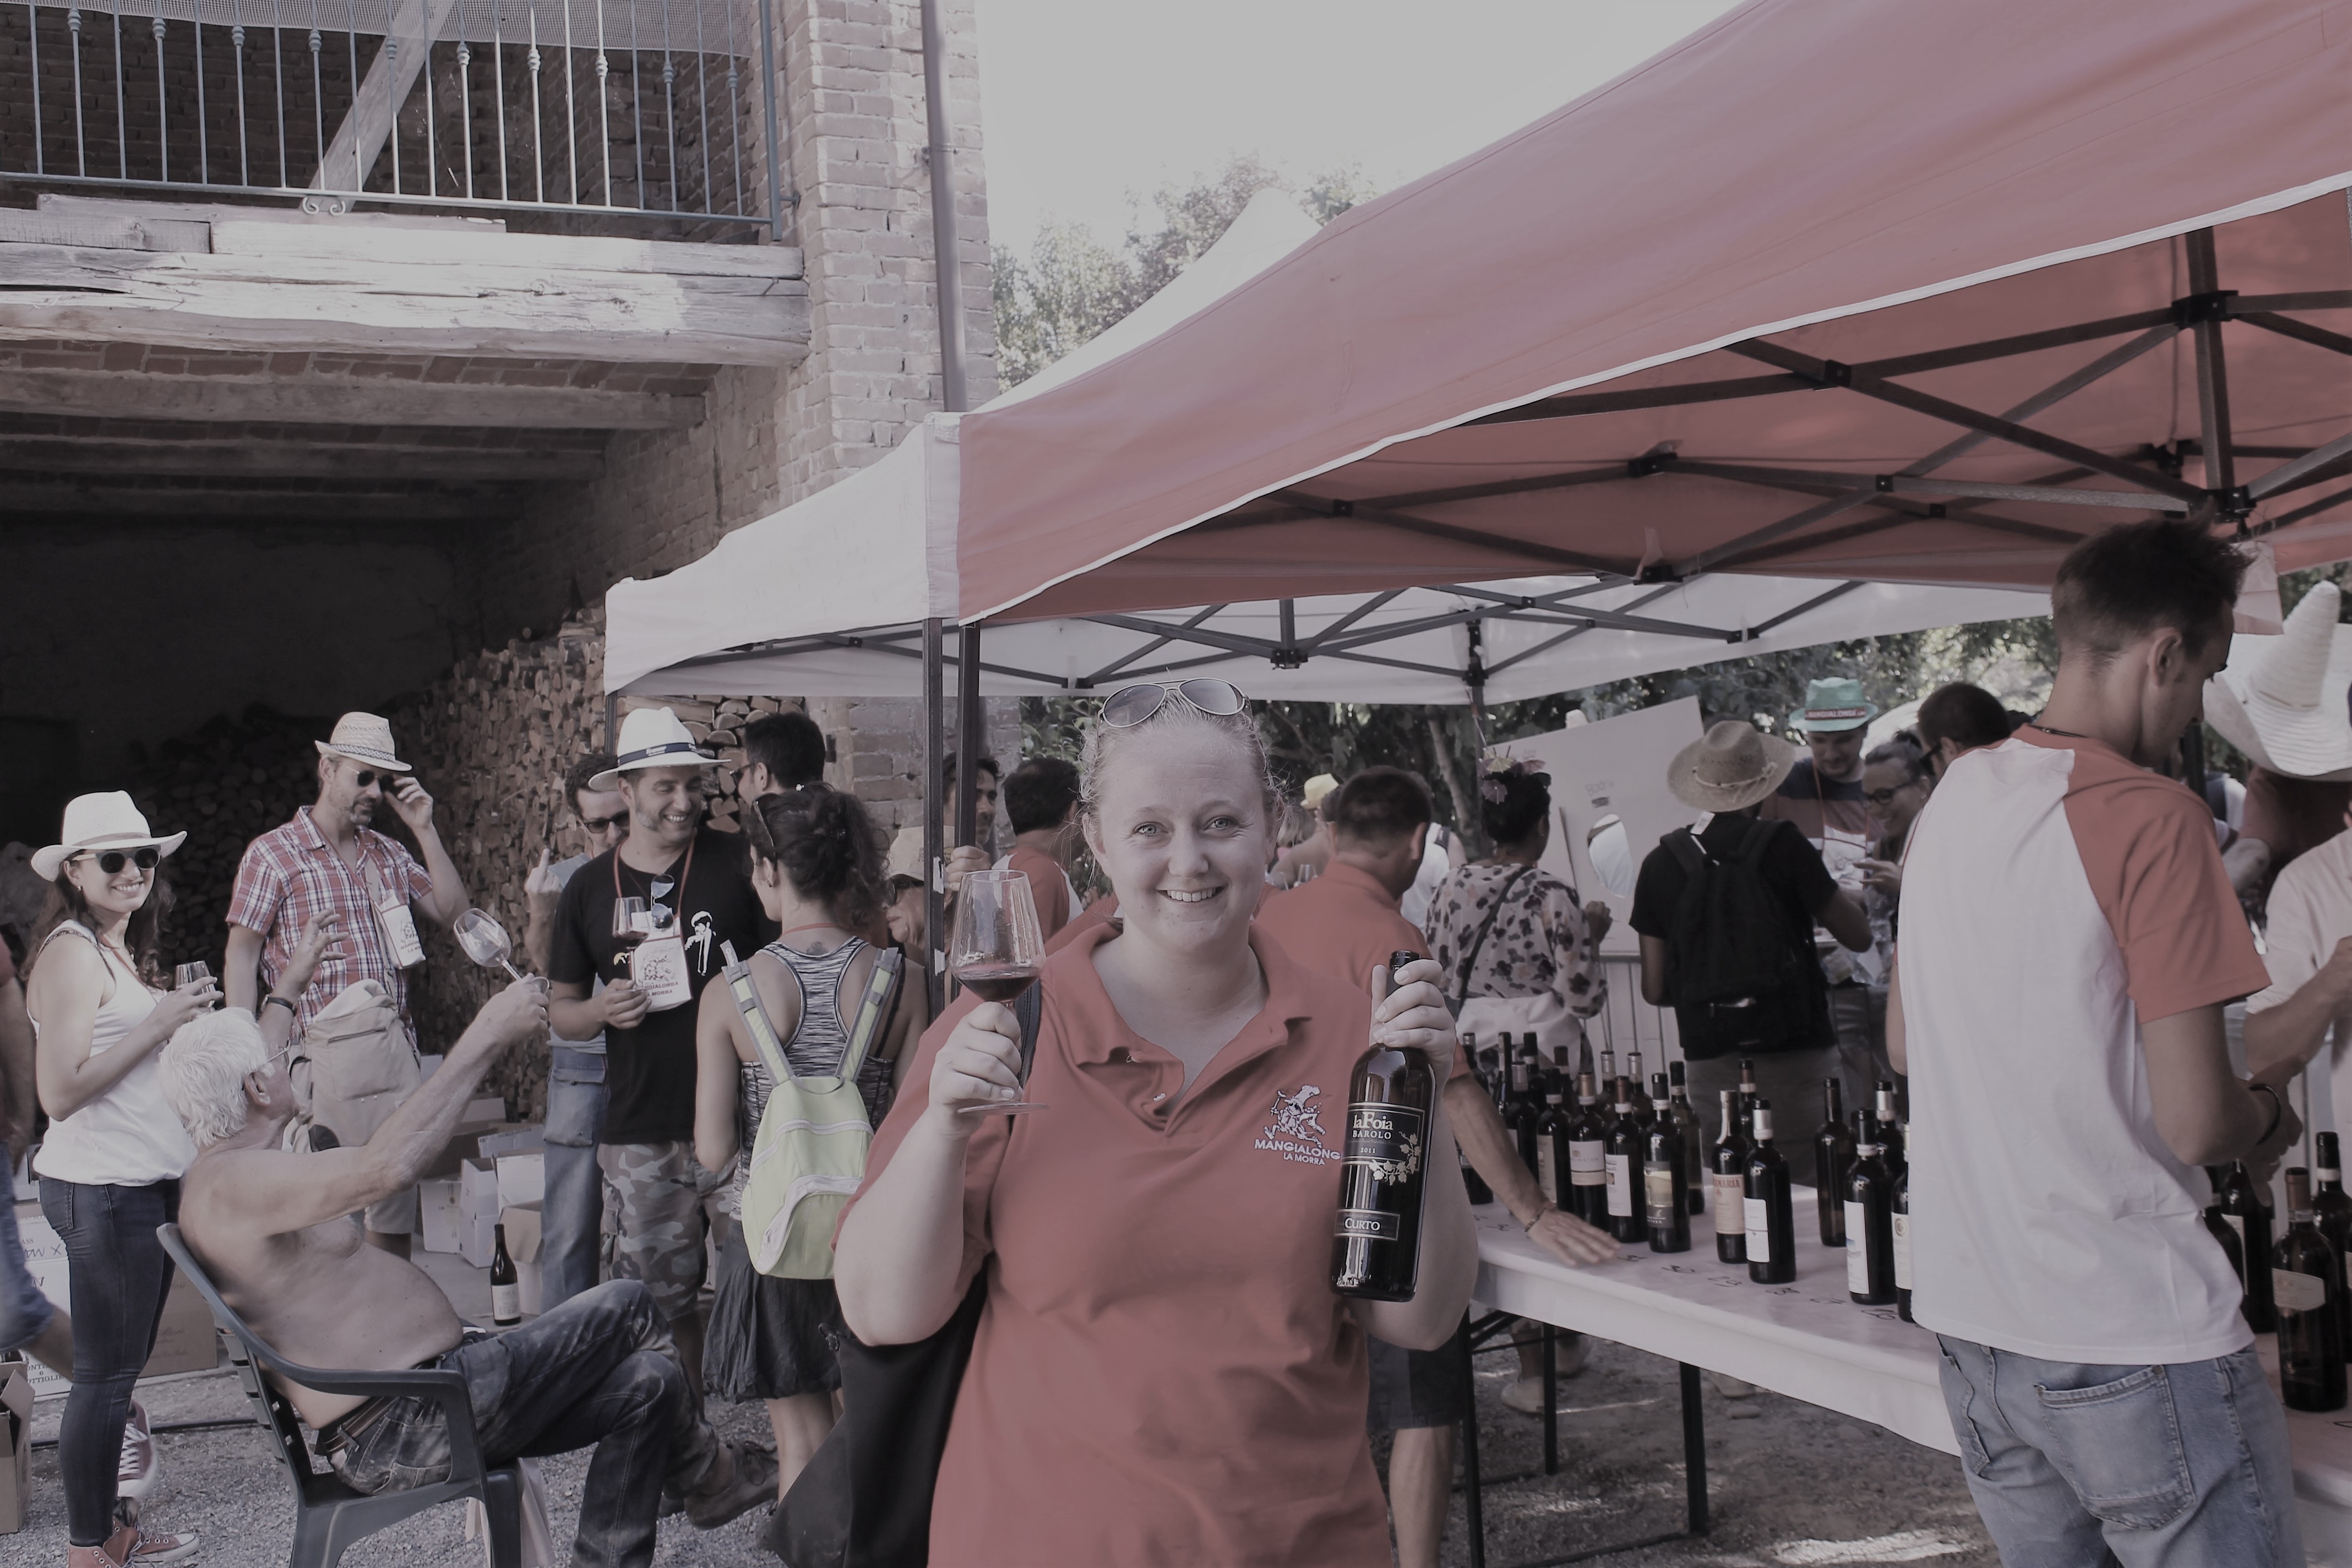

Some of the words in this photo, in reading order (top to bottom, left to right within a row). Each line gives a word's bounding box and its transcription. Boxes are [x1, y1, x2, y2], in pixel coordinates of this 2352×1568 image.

[1352, 1130, 1392, 1140] BAROLO
[1254, 1139, 1342, 1160] MANGIALONG
[1283, 1152, 1293, 1161] LA
[1294, 1155, 1325, 1166] MORRA
